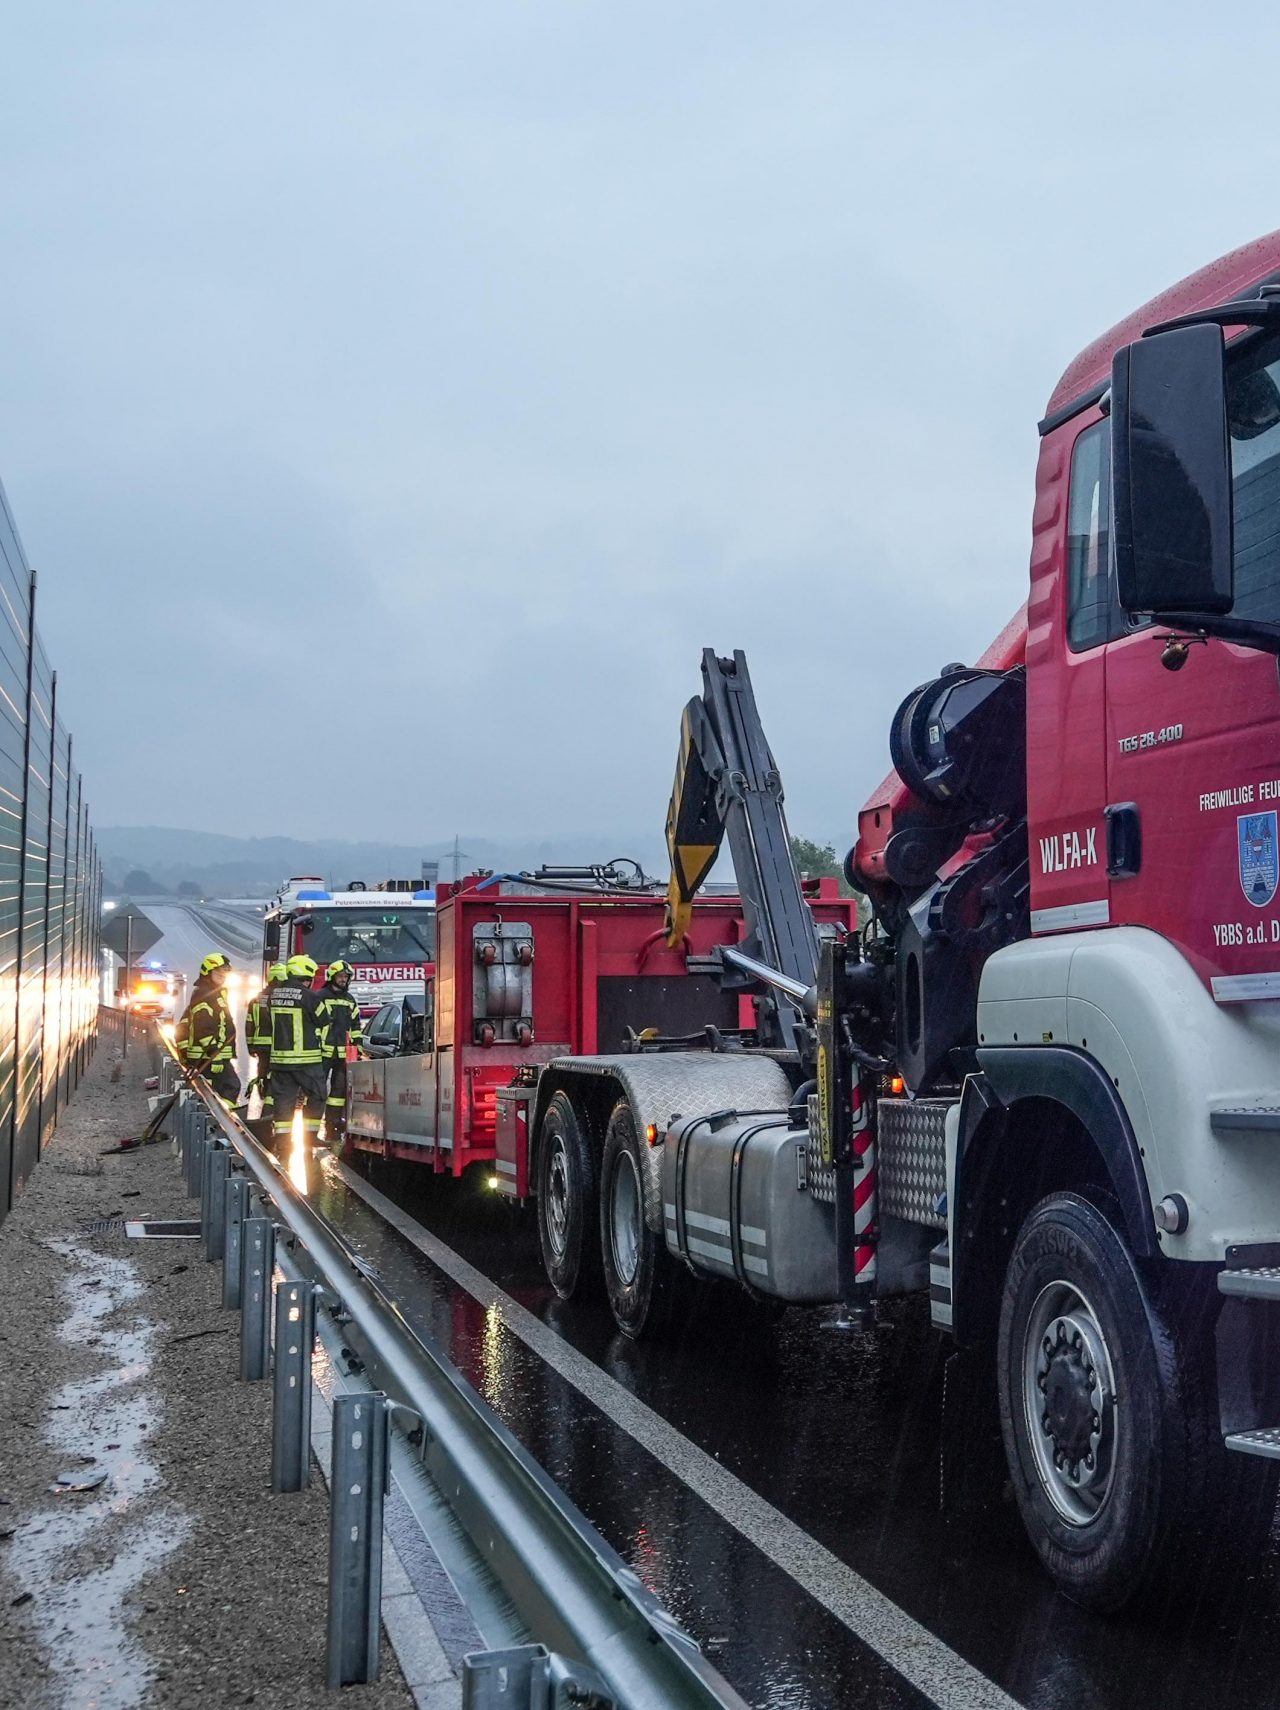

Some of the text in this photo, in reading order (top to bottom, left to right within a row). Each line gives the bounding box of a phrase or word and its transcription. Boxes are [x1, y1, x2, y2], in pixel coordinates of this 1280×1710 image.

[1118, 736, 1138, 753] TGS
[1199, 785, 1254, 811] FREIWILLIGE
[1039, 827, 1097, 874] WLFA-K
[1213, 923, 1243, 946] YBBS
[1247, 921, 1268, 944] a.d.
